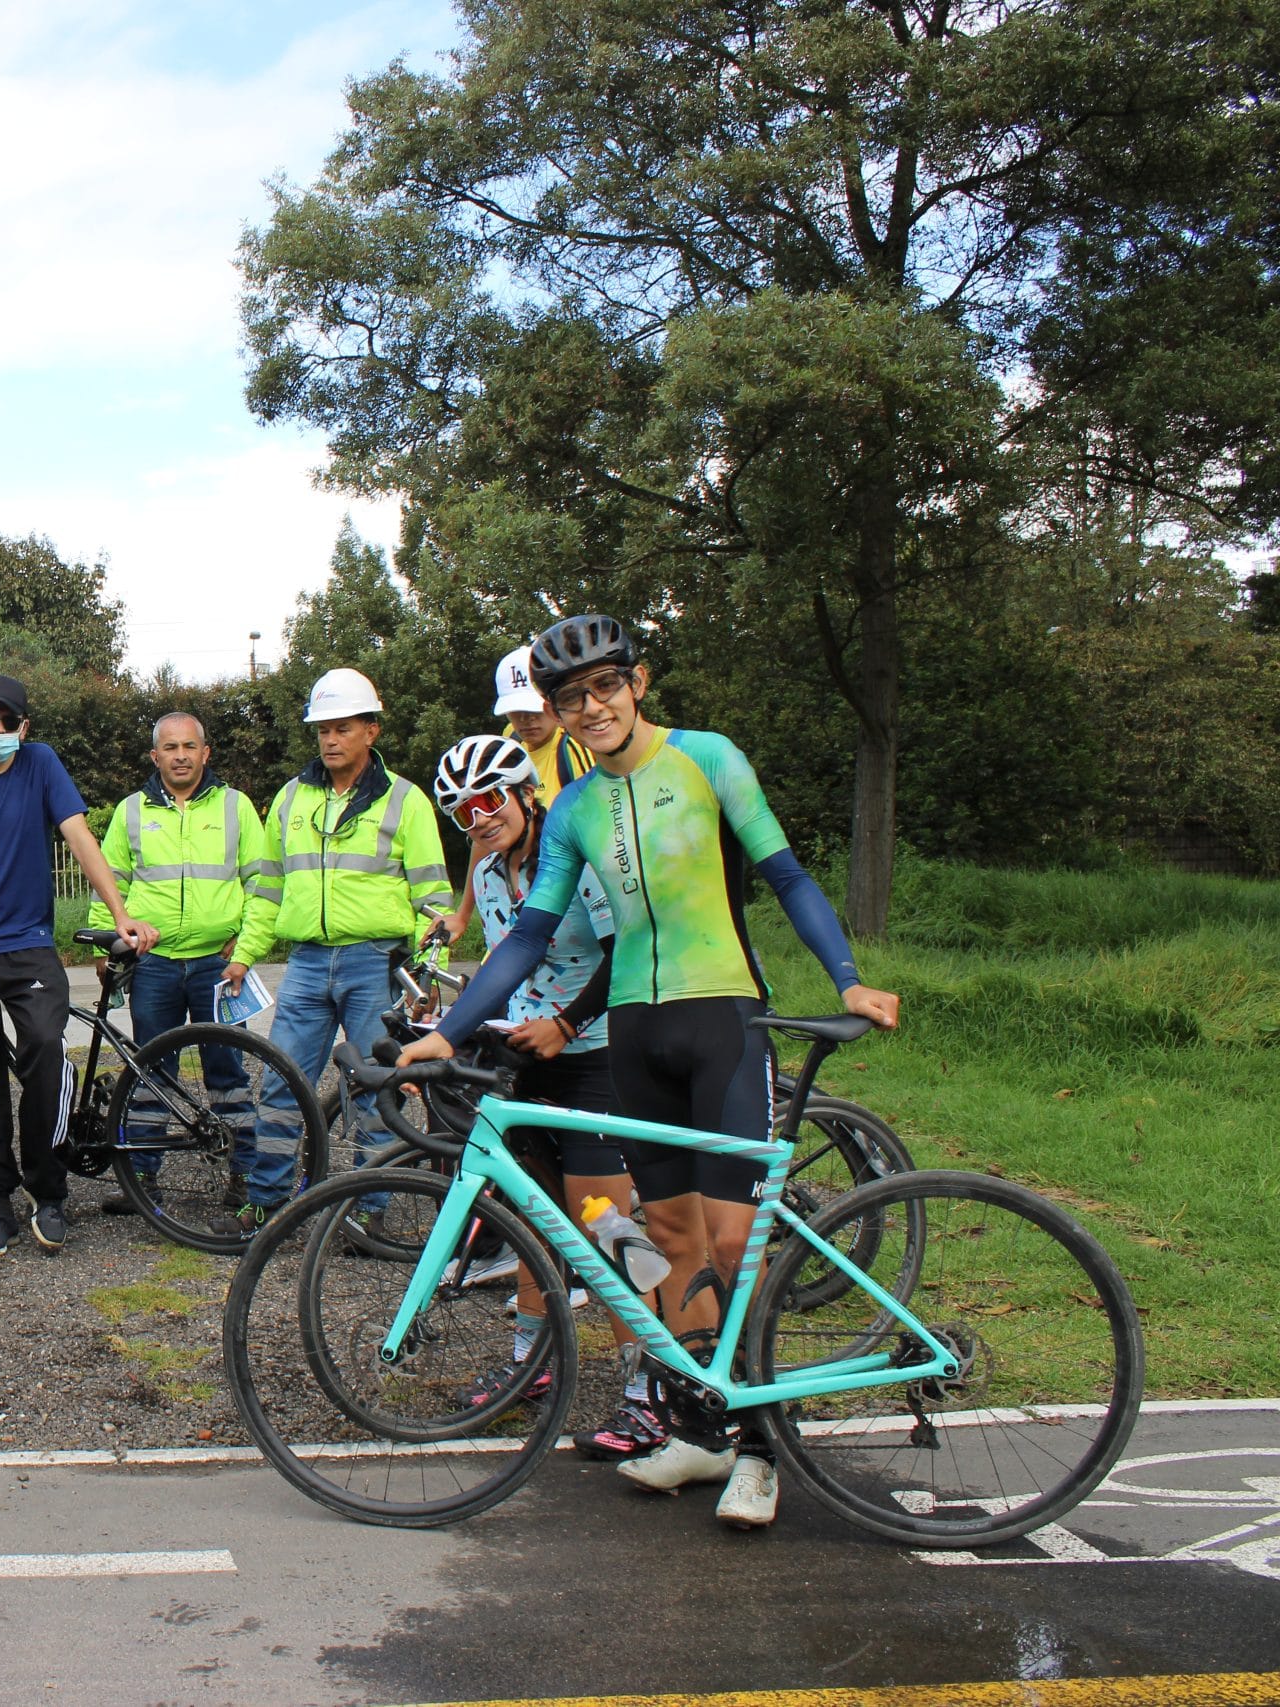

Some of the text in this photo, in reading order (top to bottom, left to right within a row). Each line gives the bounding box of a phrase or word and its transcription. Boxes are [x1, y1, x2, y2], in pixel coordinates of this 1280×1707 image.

[510, 665, 527, 688] LA
[653, 795, 674, 809] KOM
[609, 788, 631, 874] celucambio
[520, 1193, 673, 1350] SPECIALIZED
